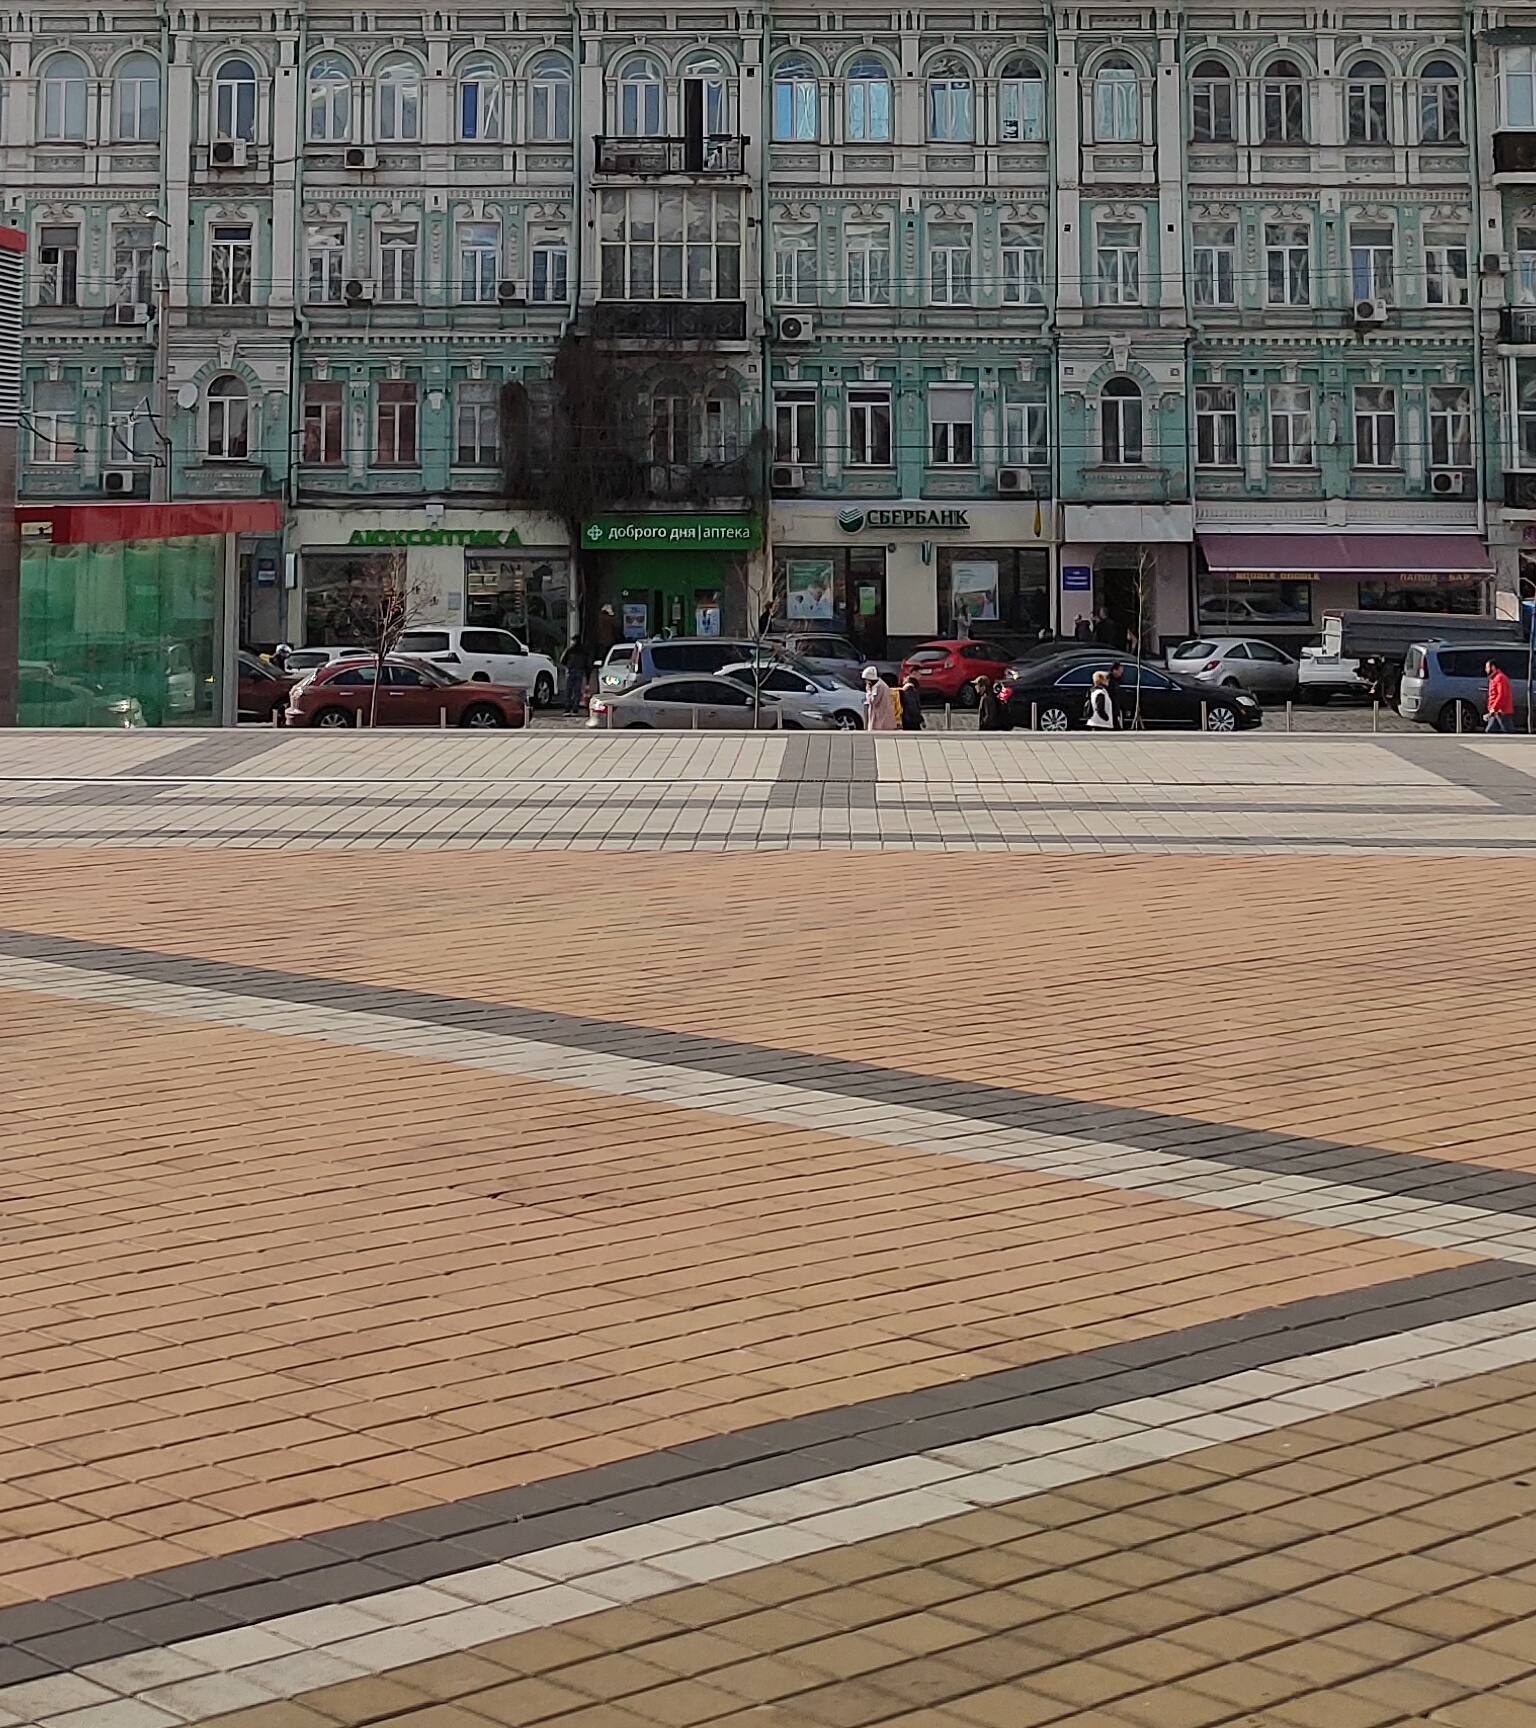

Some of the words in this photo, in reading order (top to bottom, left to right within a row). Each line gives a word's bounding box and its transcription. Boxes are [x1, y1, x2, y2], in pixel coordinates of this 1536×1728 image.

[867, 509, 969, 525] СБЕРБАНК
[348, 528, 523, 547] ЛЮКСОПТИКА
[607, 524, 667, 541] доброго
[669, 526, 696, 542] дня
[702, 527, 751, 539] аптека
